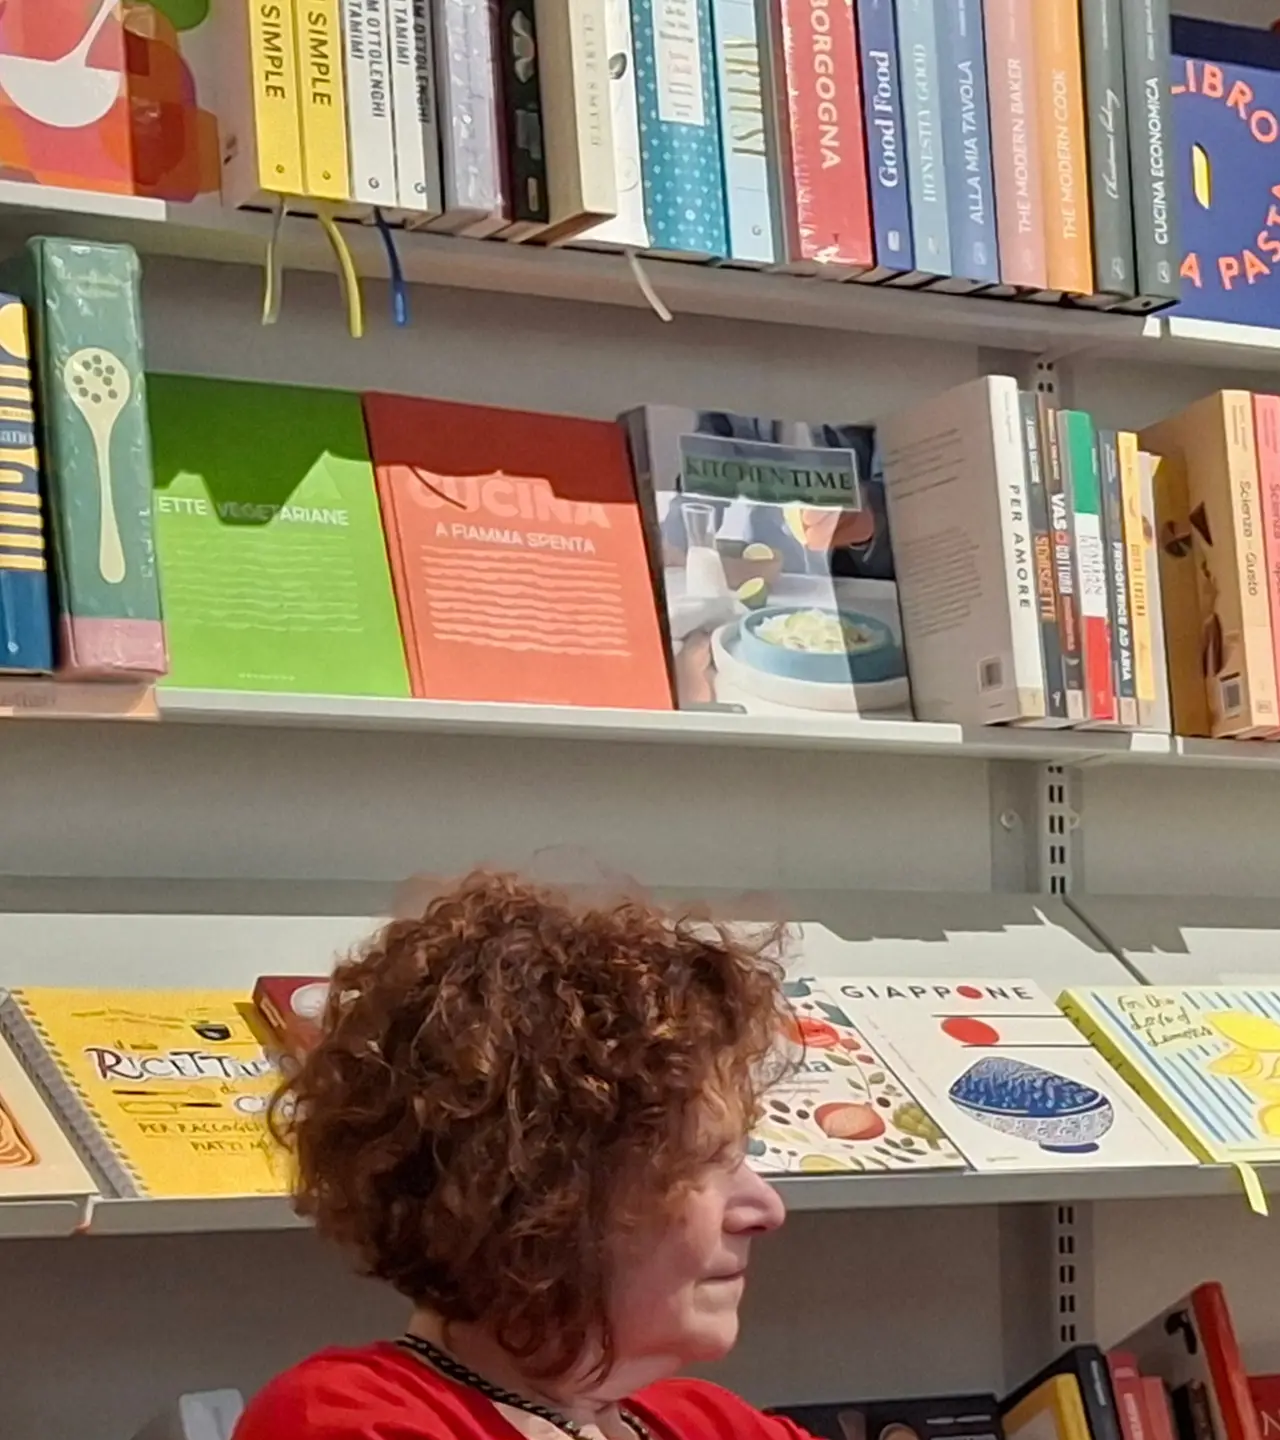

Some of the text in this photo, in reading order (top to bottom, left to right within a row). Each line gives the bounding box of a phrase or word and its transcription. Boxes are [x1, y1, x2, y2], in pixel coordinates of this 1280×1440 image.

[260, 3, 286, 99] SIMPLE
[307, 11, 332, 107] SIMPLE
[348, 2, 365, 60] TAMIMI
[366, 16, 386, 119] OTTOLENGHI
[395, 7, 411, 65] TAMIMI
[869, 50, 898, 188] Good Food
[957, 60, 985, 225] ALLA MIA TAVOLA
[1010, 120, 1031, 197] MODERN
[1145, 77, 1169, 245] CUCINA ECONOMICA
[1016, 198, 1033, 233] THE
[405, 466, 612, 529] CUCINA
[452, 525, 523, 546] FIAMMA
[526, 531, 597, 555] SPENTA
[1240, 481, 1260, 596] Scienza Gusto
[1009, 484, 1031, 609] PER AMORE
